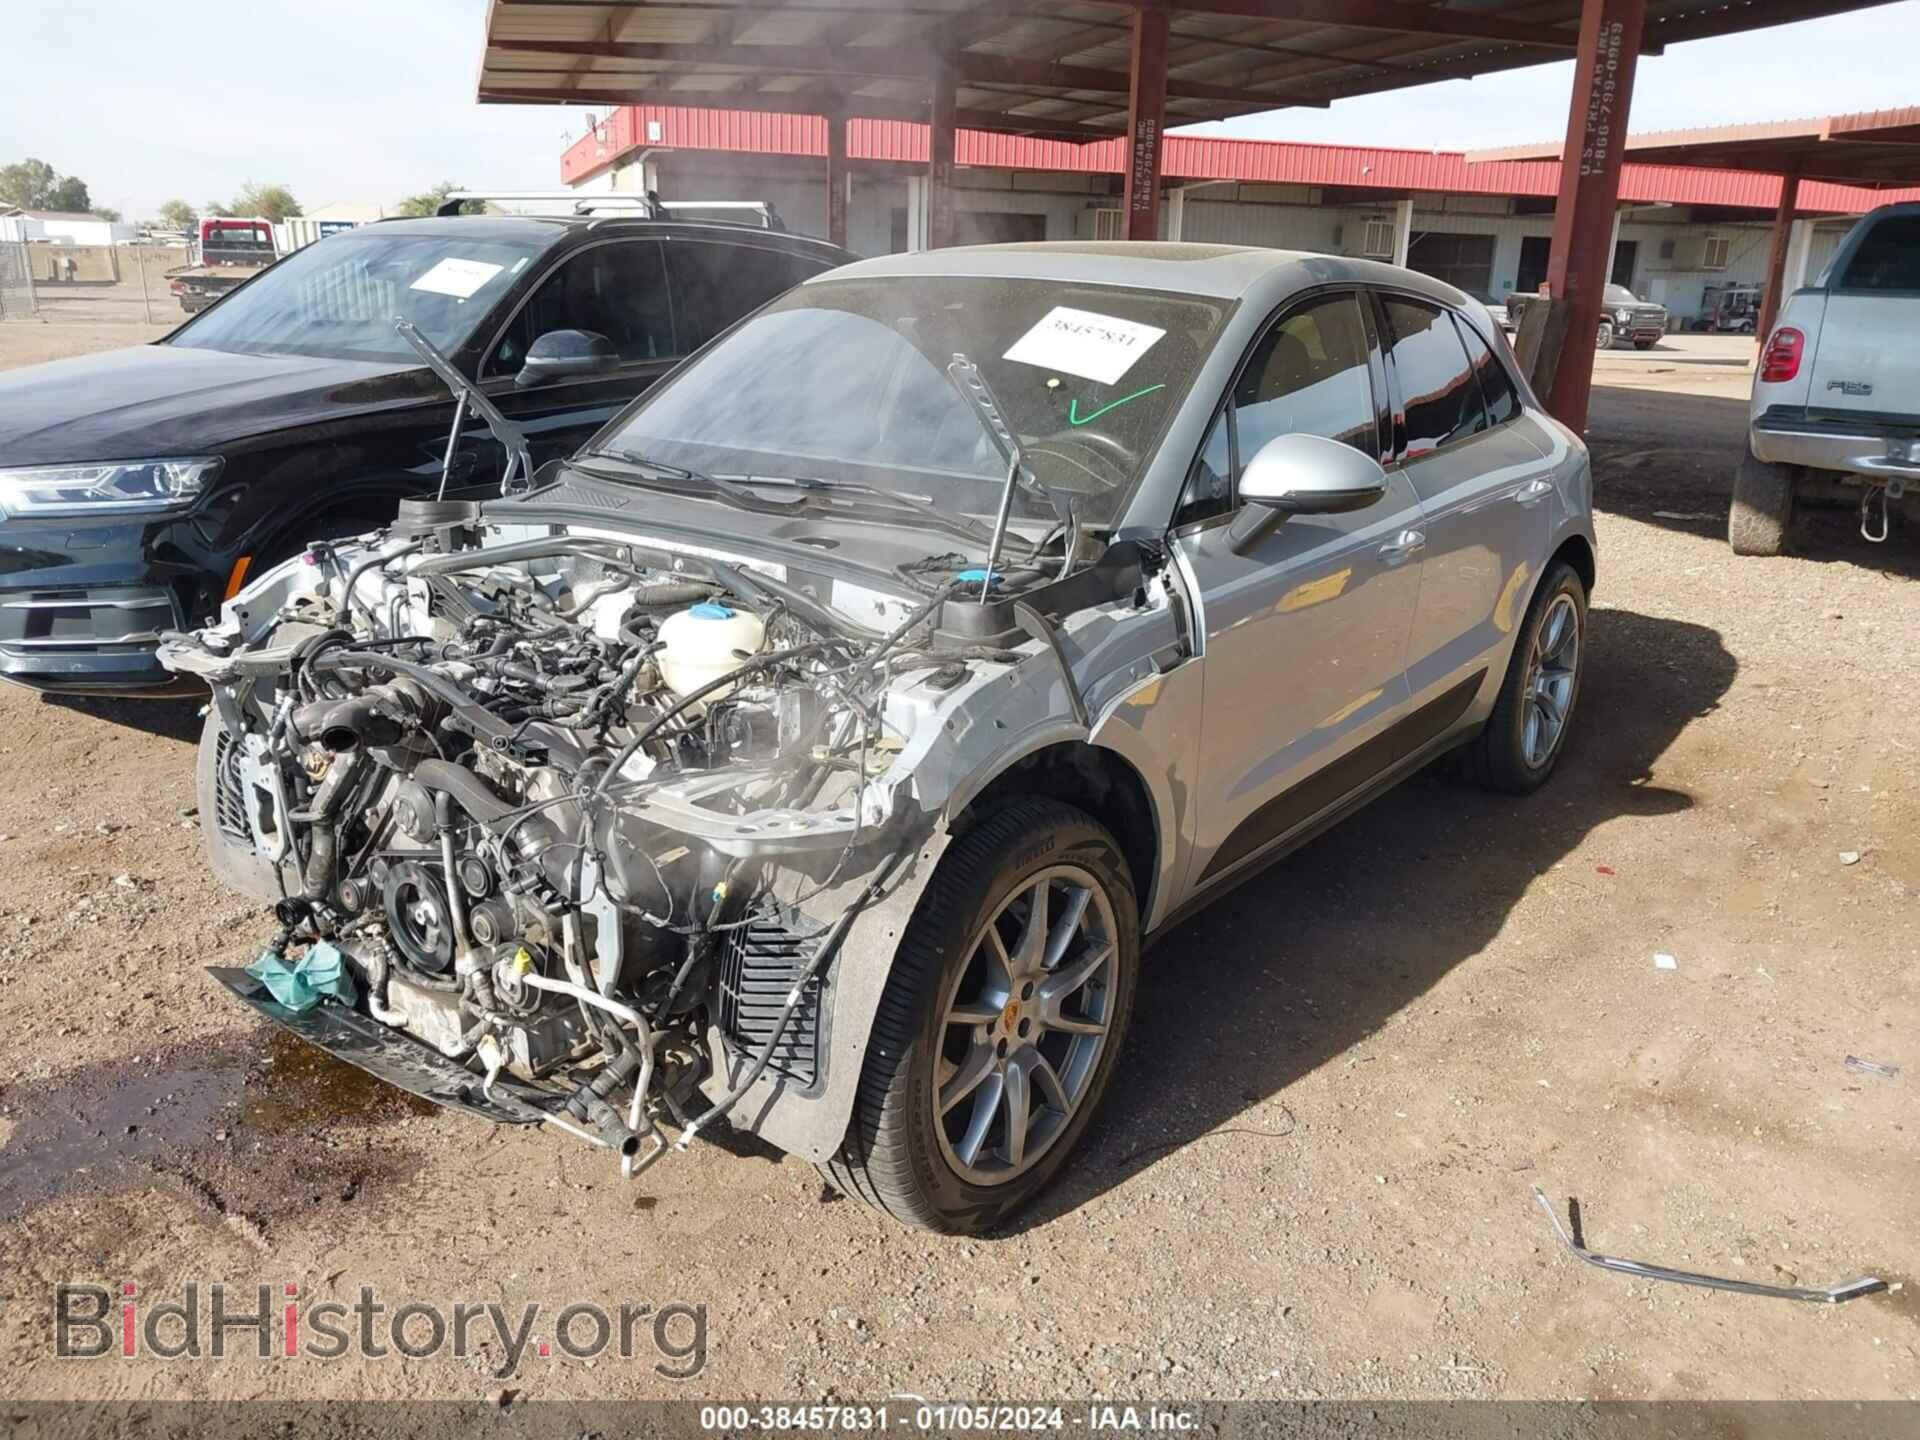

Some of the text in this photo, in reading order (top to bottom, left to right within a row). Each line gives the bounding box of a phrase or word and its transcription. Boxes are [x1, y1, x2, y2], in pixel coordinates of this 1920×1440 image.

[1580, 20, 1611, 176] U.S. PREFAB INC.
